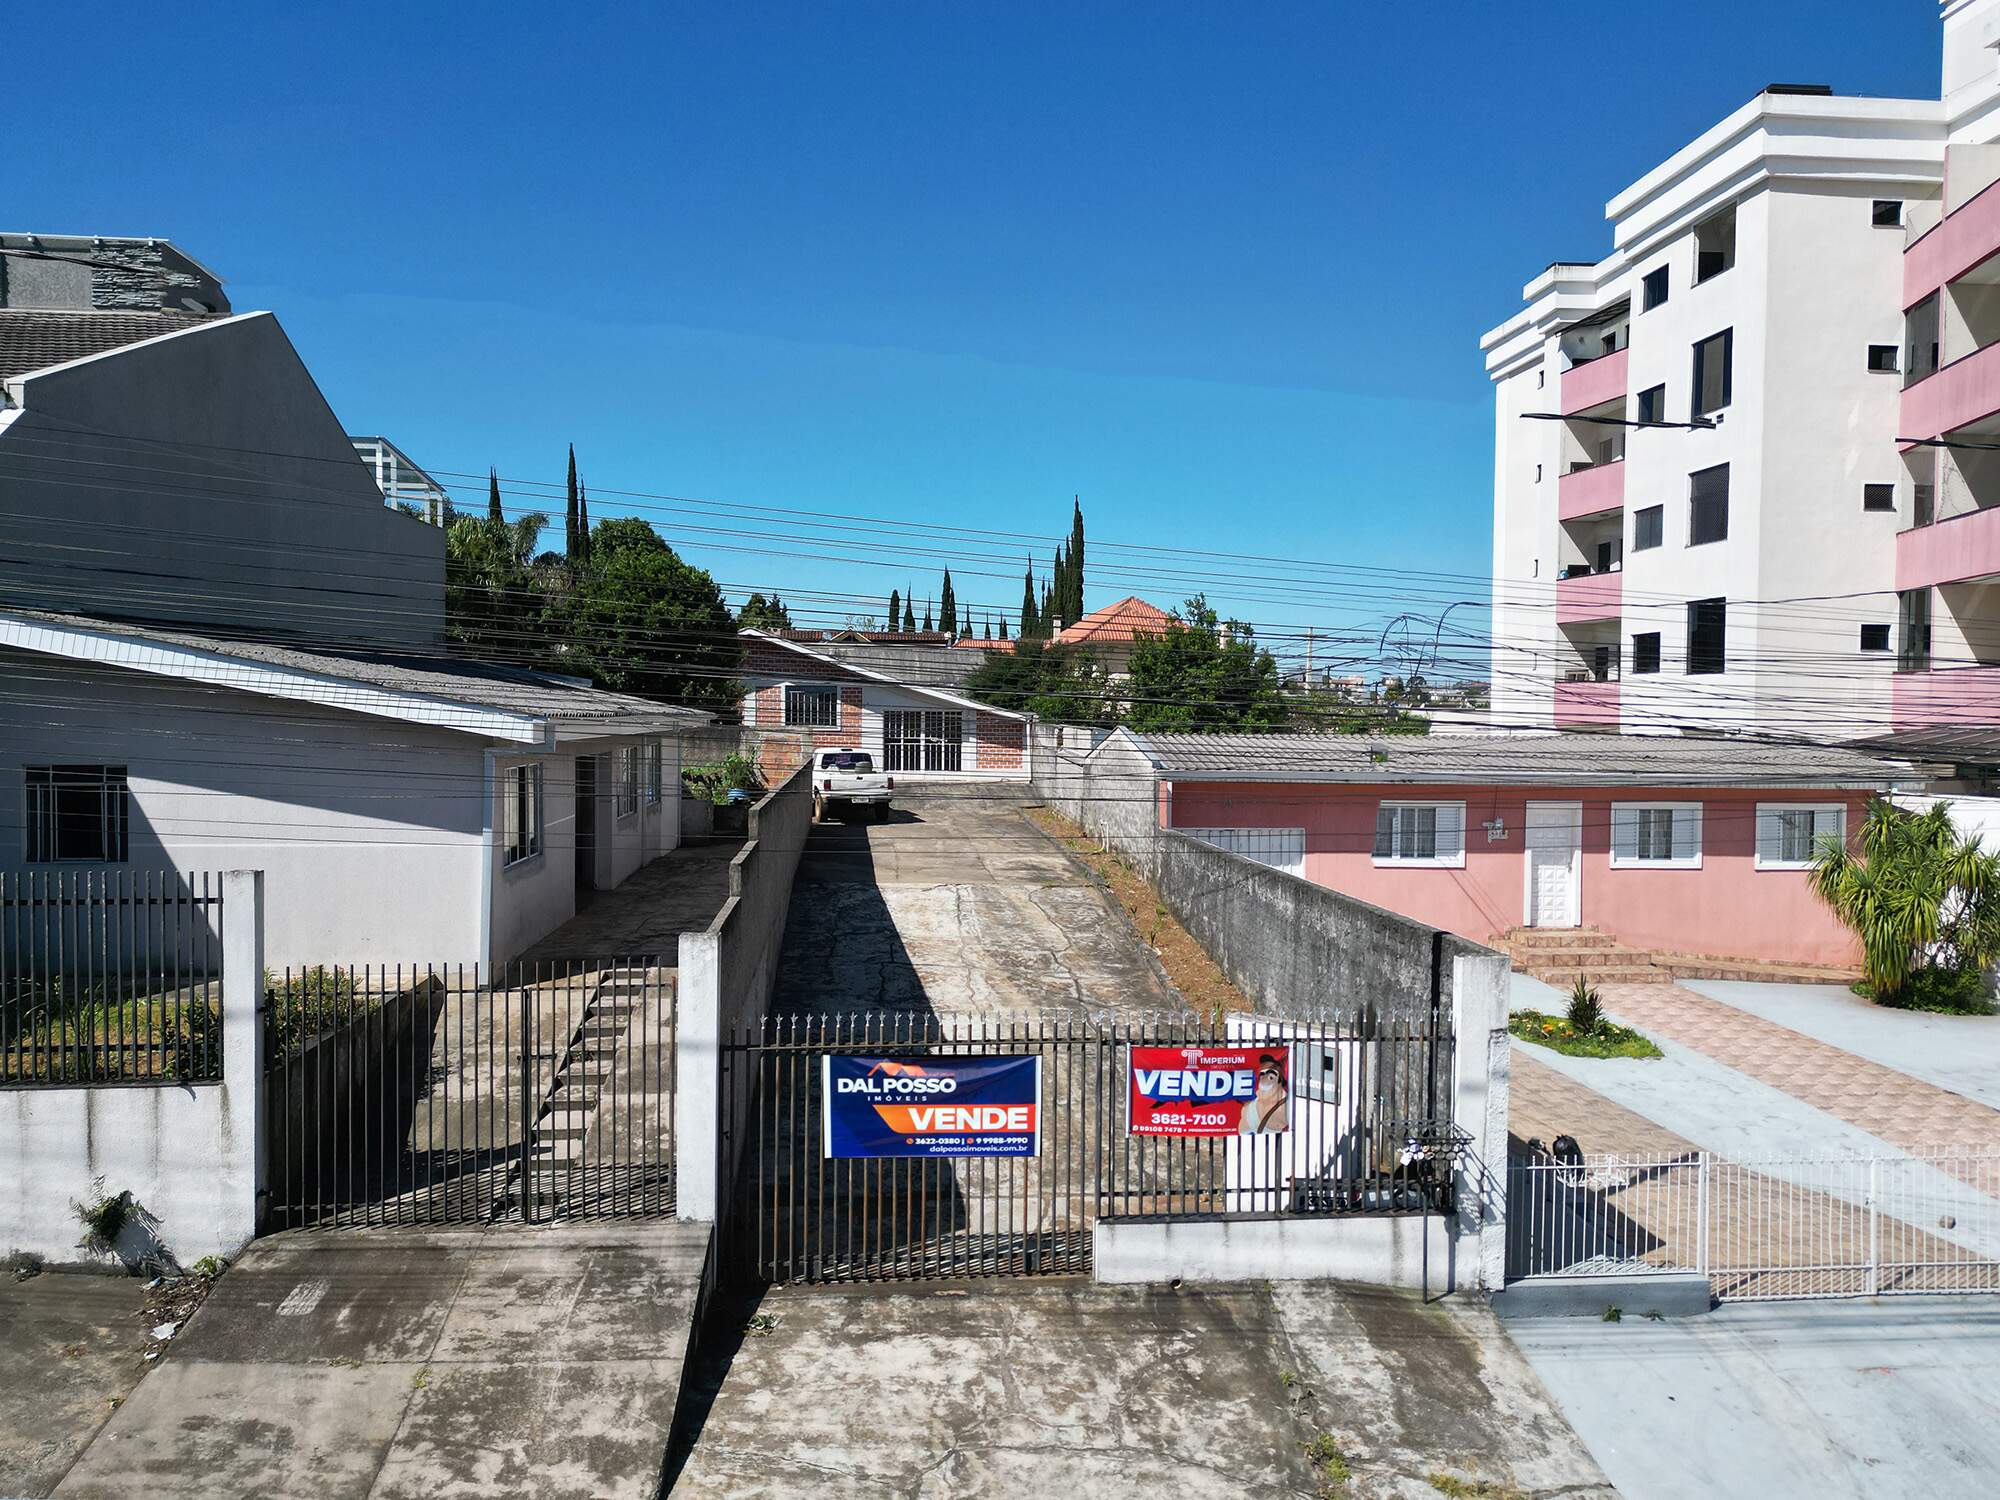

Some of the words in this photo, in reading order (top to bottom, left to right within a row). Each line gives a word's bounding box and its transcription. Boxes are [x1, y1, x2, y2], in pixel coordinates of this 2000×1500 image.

[1200, 1056, 1245, 1064] IMPERIUM
[837, 1078, 880, 1093] DAL
[883, 1078, 957, 1093] POSSO
[1134, 1069, 1253, 1097] VENDE
[907, 1107, 1028, 1130] VENDE
[1151, 1113, 1227, 1125] 3621-7100
[915, 1137, 960, 1145] 3622-0380
[982, 1137, 1028, 1145] 9988-9990
[929, 1145, 1028, 1153] dalpossoimoveis.com.br
